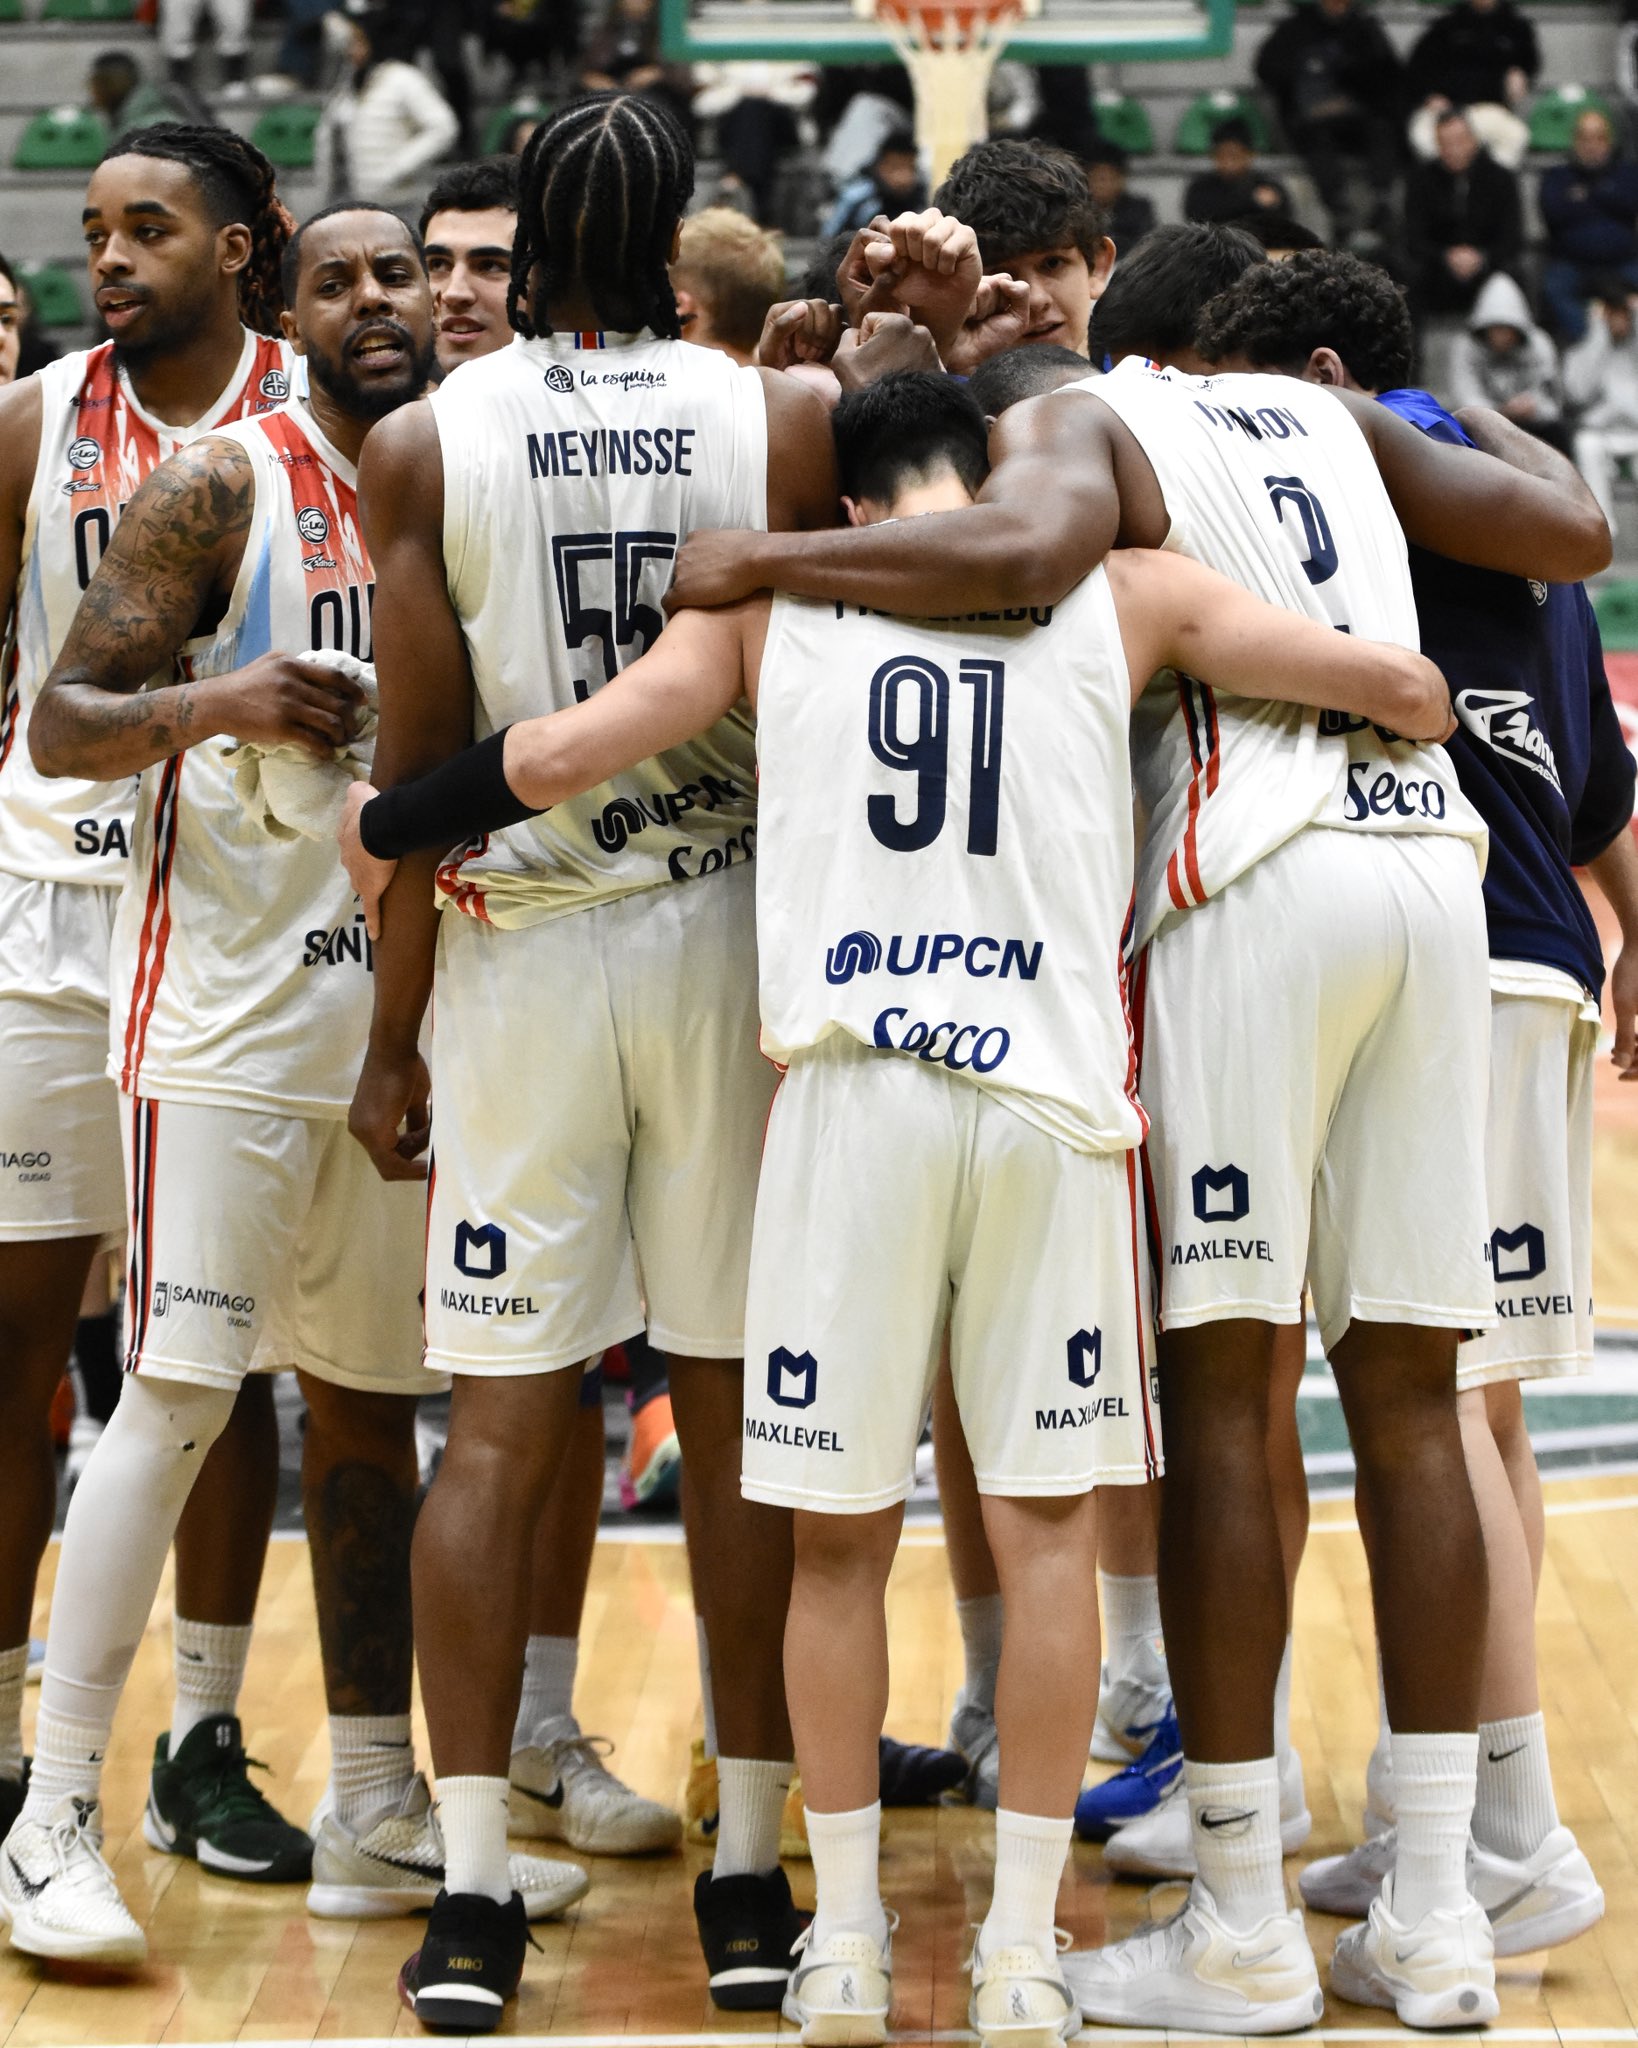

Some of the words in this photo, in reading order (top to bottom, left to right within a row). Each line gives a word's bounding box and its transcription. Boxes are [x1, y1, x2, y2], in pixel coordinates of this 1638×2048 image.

[580, 369, 598, 387] la
[526, 428, 696, 479] MEYINSSE
[551, 531, 678, 704] 55
[867, 655, 1005, 857] 91
[74, 818, 134, 858] SA
[886, 933, 1044, 981] UPCN
[867, 1007, 1011, 1074] Secco
[1170, 1238, 1274, 1265] MAXLEVEL
[173, 1285, 256, 1314] SANTIAGO
[441, 1287, 540, 1316] MAXLEVEL
[1035, 1397, 1130, 1430] MAXLEVEL
[745, 1417, 844, 1453] MAXLEVEL
